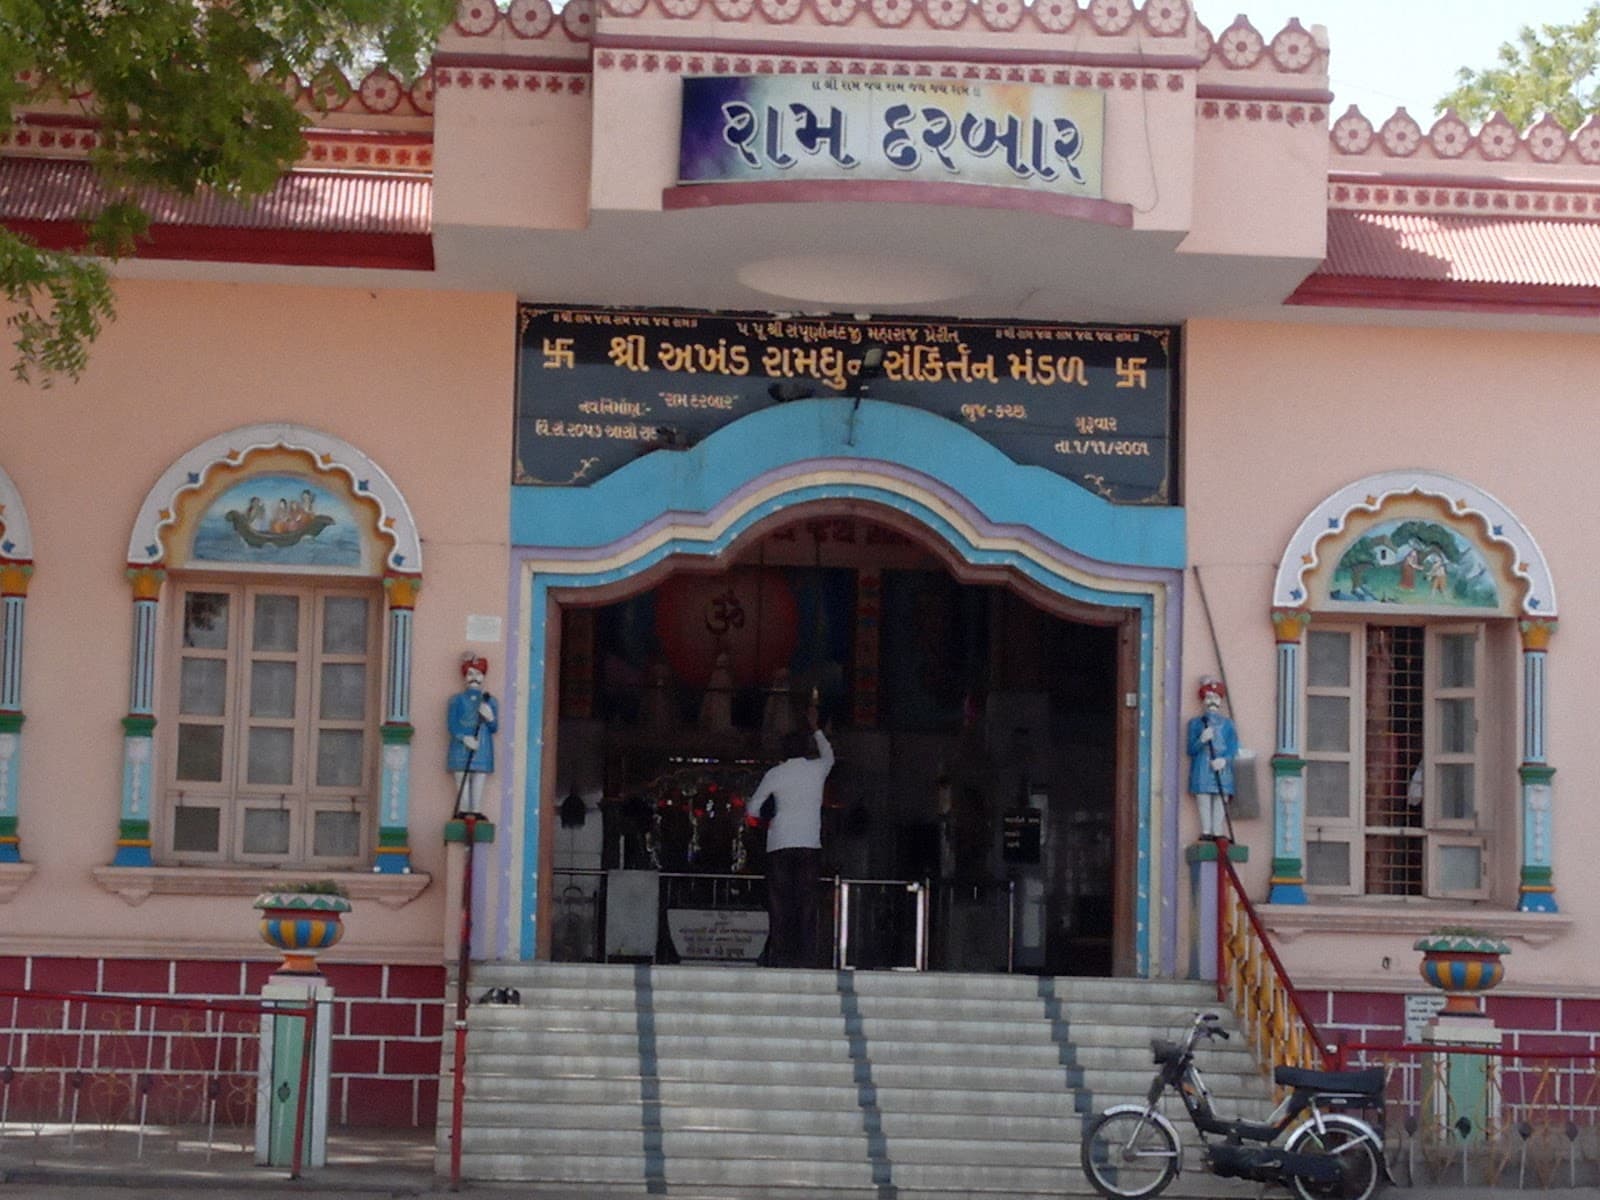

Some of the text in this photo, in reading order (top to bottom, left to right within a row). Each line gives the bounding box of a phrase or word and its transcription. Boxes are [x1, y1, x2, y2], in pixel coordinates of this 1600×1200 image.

[841, 80, 861, 92] રામ
[864, 82, 882, 92] જય
[886, 81, 905, 93] રામ
[909, 83, 927, 94] જય
[721, 101, 1087, 185] રામ દરબાર
[867, 325, 919, 345] મહારાજ
[608, 335, 649, 372] શ્રી
[658, 338, 750, 376] અખંડ
[883, 343, 999, 383] સંકિર્તન
[1007, 348, 1089, 387] મંડળ
